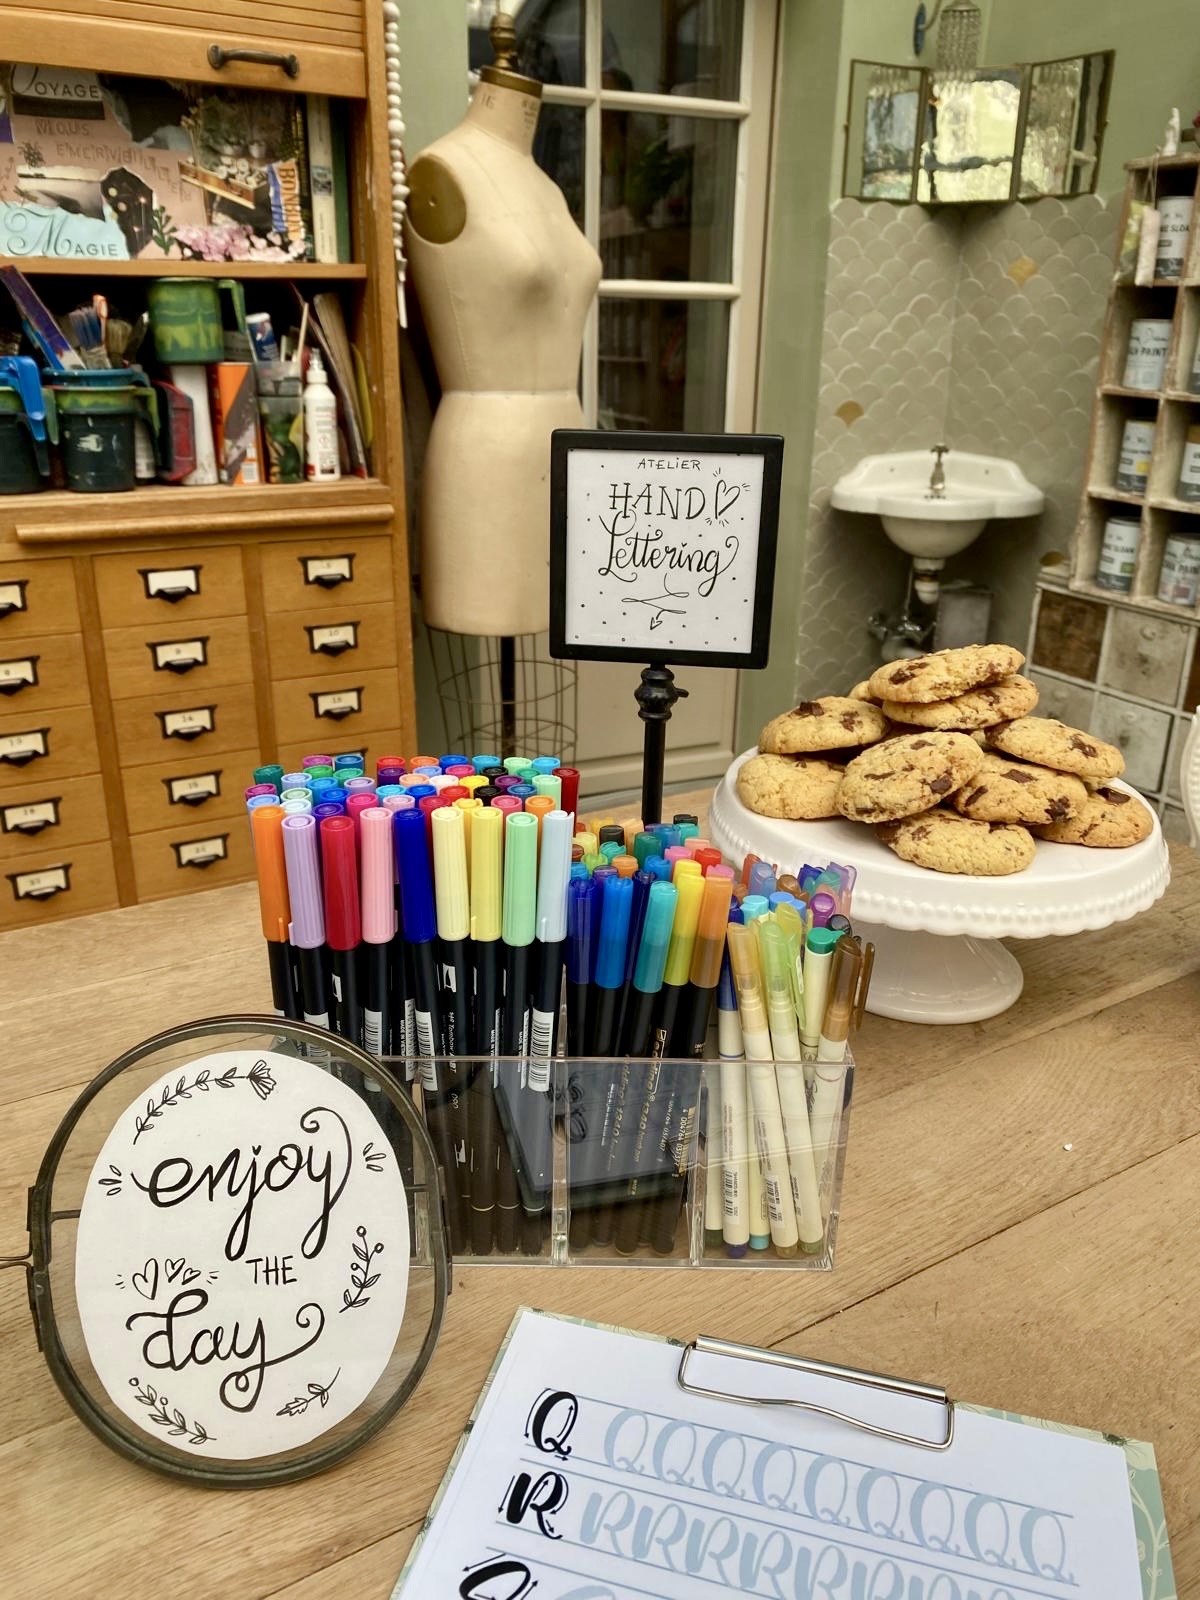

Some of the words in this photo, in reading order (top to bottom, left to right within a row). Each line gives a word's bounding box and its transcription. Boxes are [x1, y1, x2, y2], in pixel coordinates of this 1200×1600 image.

[4, 208, 119, 257] MAGIE
[637, 457, 701, 471] ATELIER
[608, 482, 706, 520] HAND
[598, 508, 739, 597] Lettering
[131, 1107, 353, 1261] enjoy
[246, 1255, 298, 1286] THE
[126, 1288, 325, 1412] day
[532, 1391, 579, 1456] Q
[506, 1471, 564, 1540] R
